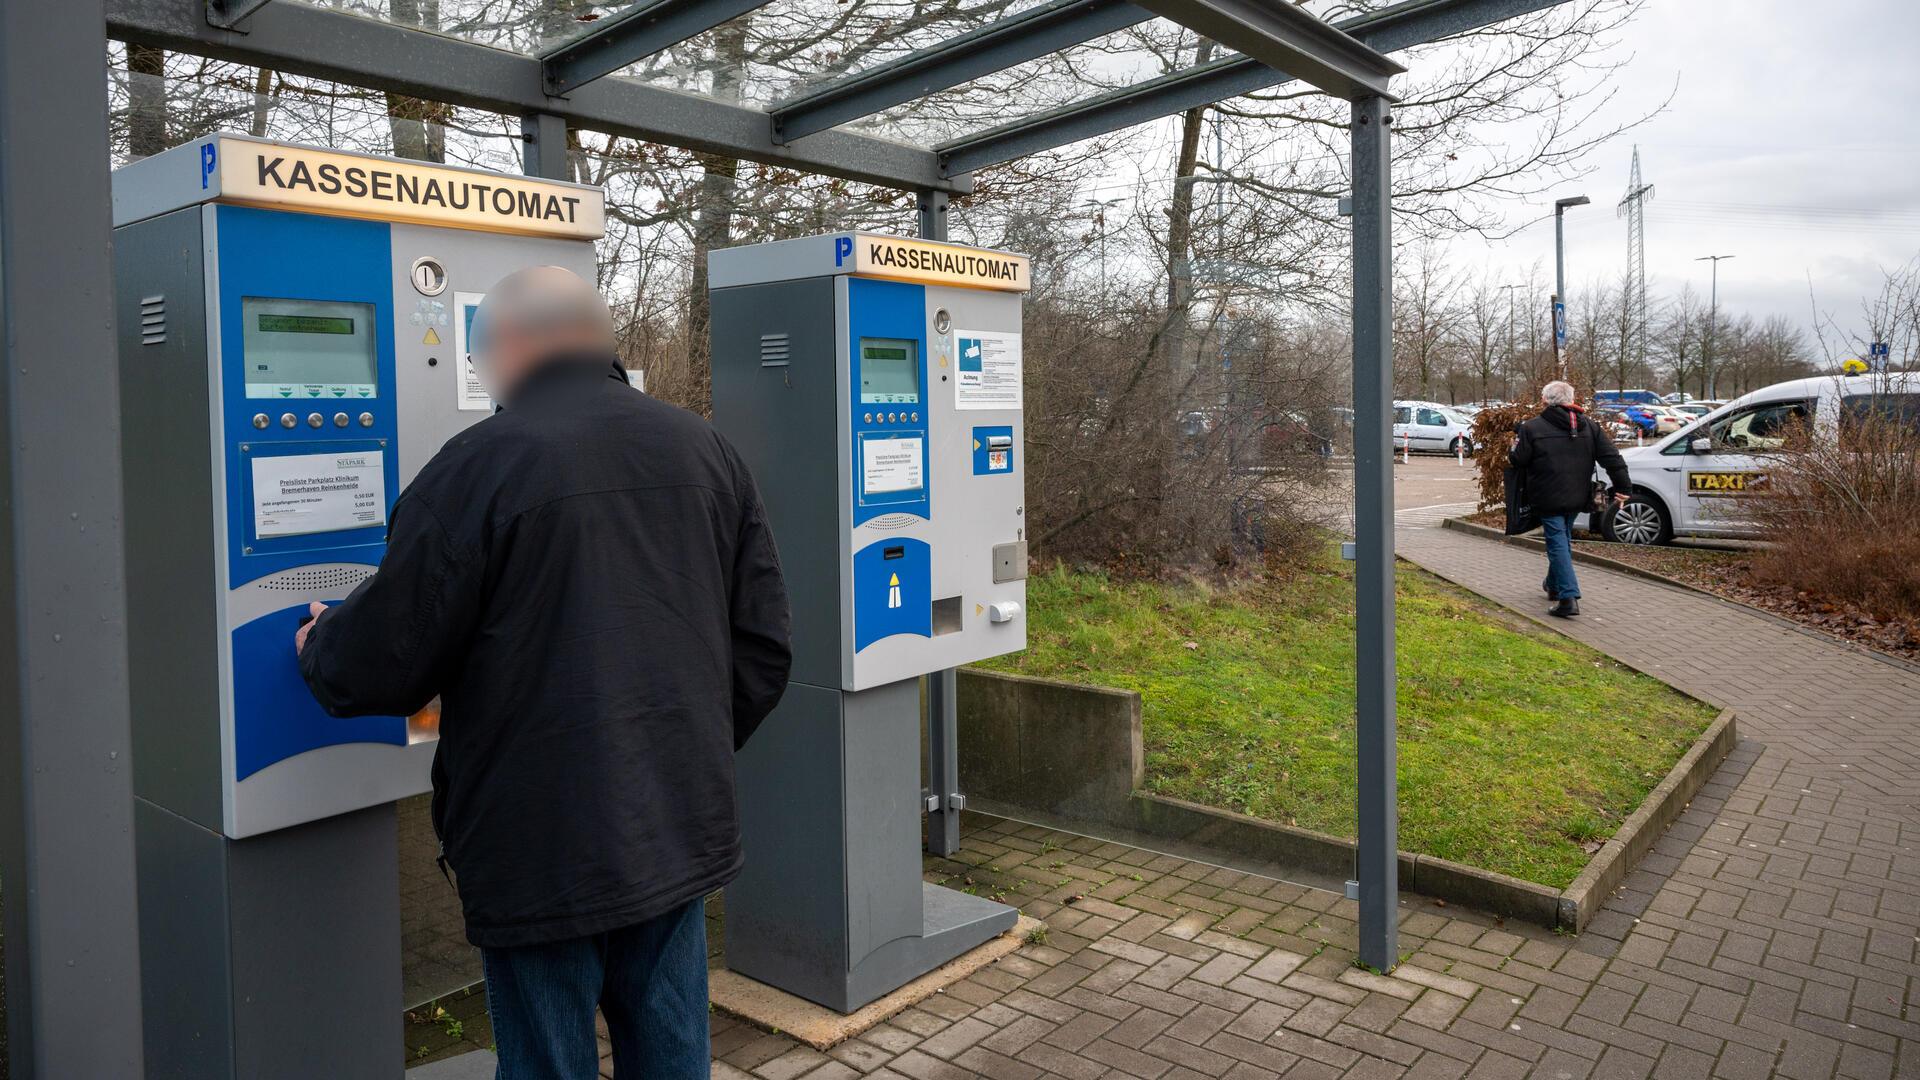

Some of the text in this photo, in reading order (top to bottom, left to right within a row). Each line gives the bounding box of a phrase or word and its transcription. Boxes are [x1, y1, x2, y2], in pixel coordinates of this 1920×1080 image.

[201, 143, 216, 190] P
[257, 155, 580, 223] KASSENAUTOMAT
[835, 236, 853, 267] P
[870, 243, 1019, 281] KASSENAUTOMAT
[281, 483, 359, 494] Bremerhaven Reinkenheide
[308, 476, 334, 485] Parkplatz
[1691, 474, 1744, 489] TAXI
